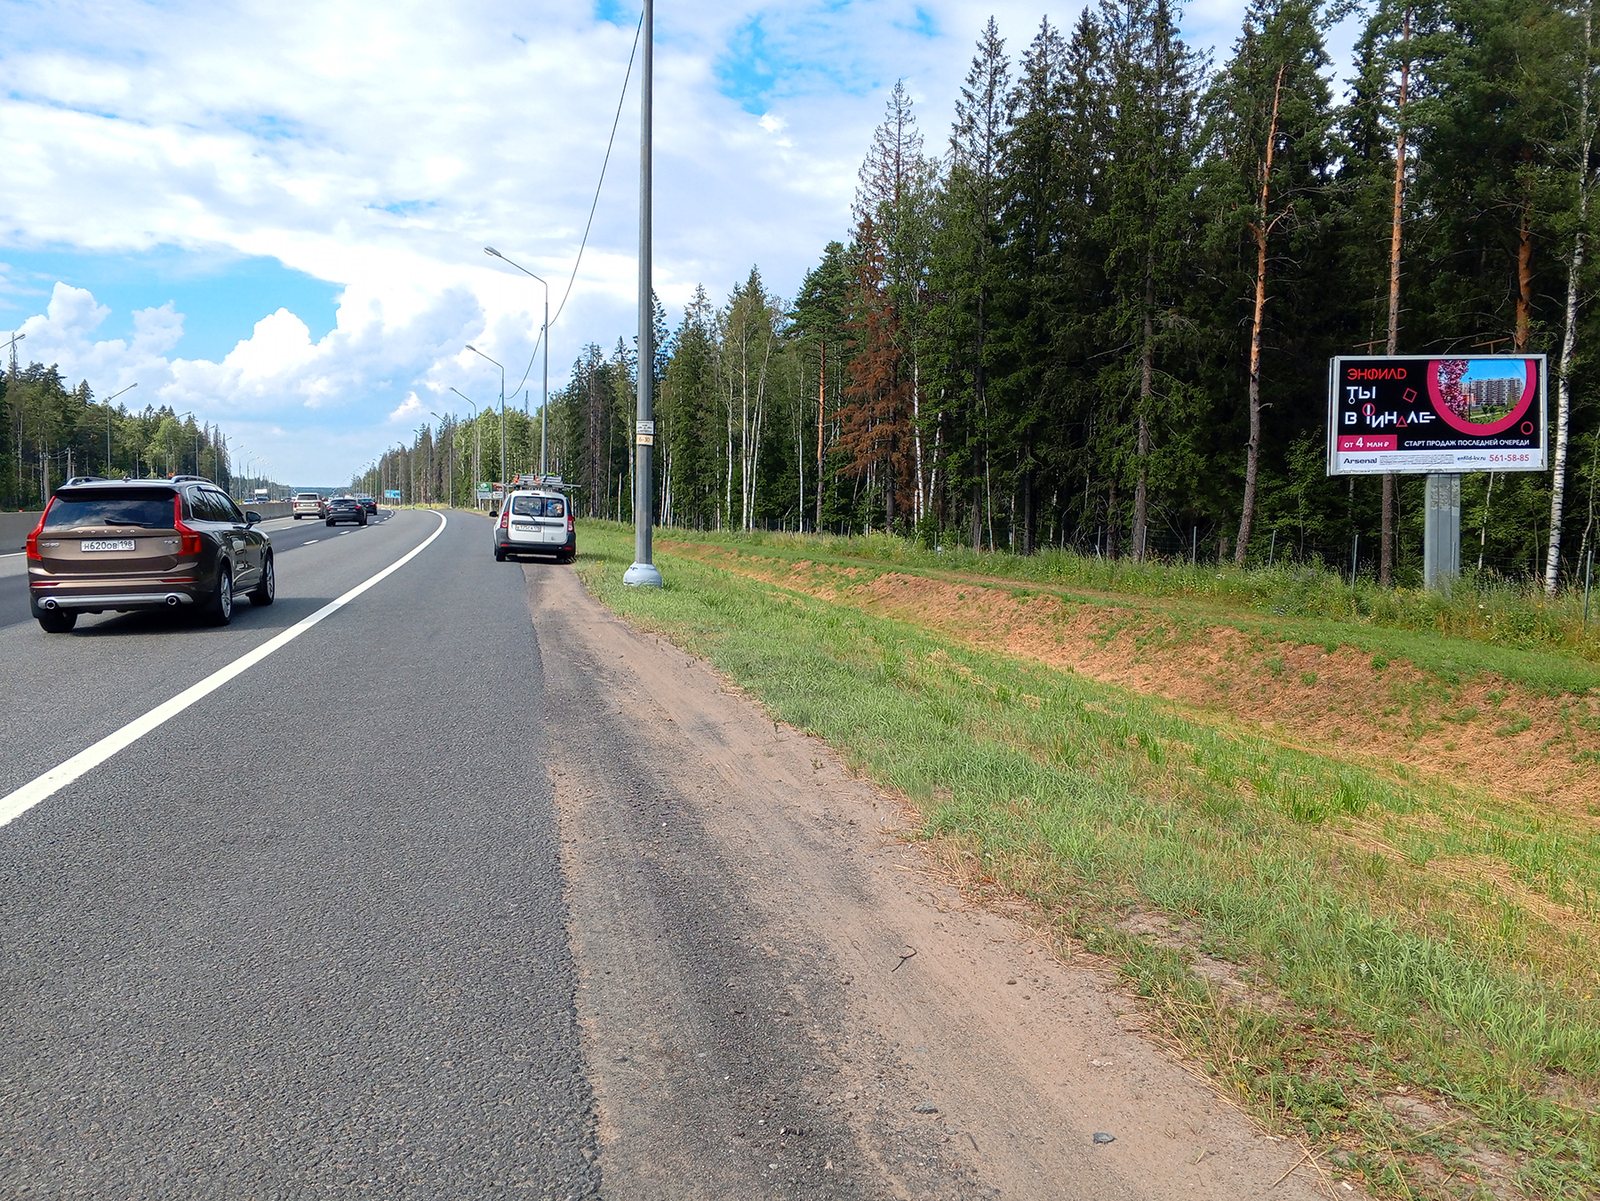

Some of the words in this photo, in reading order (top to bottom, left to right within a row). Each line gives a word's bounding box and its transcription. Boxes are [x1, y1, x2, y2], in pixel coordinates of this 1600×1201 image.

[1346, 386, 1376, 405] ТЫ
[1345, 412, 1357, 424] В
[1355, 437, 1364, 448] 4
[1426, 439, 1457, 447] ПРОДАЖ
[1457, 438, 1498, 446] ПОСЛЕДНЕЙ
[1489, 454, 1530, 462] 561-58-85
